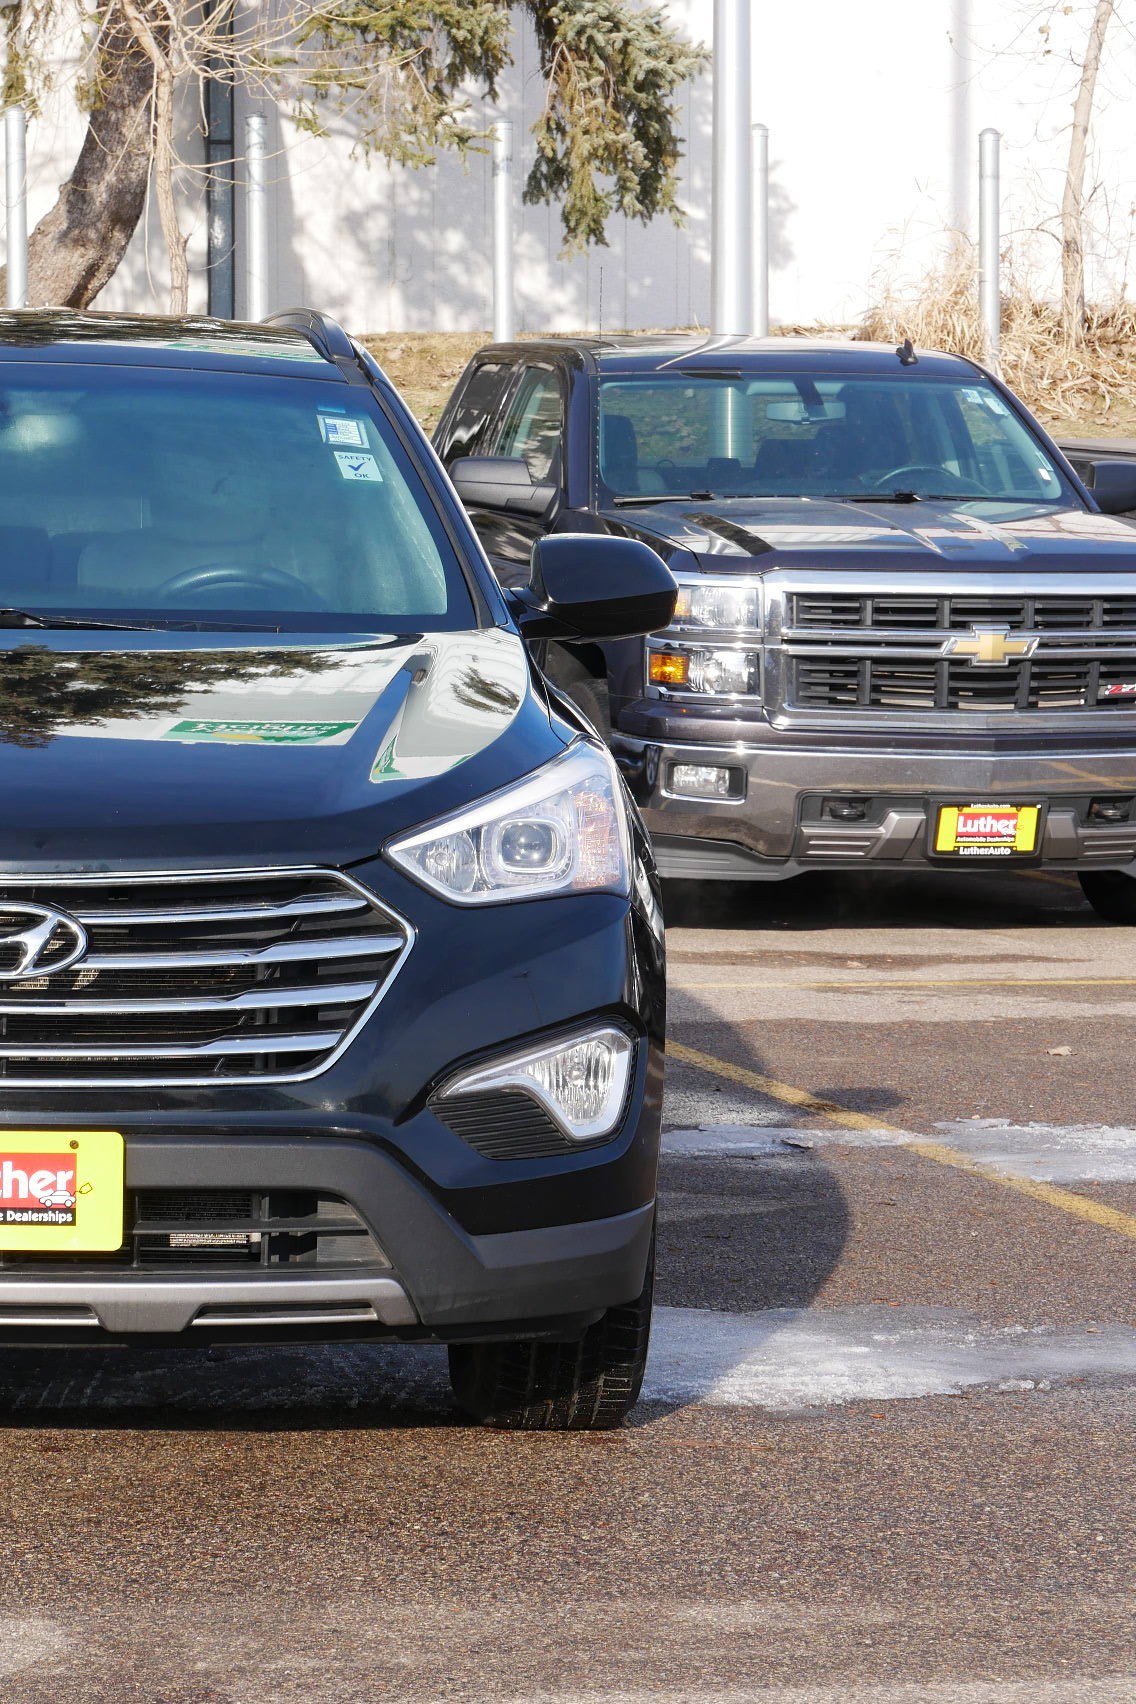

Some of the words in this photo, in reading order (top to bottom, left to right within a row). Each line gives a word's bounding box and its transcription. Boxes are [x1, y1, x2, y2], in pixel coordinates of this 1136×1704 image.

[338, 454, 371, 462] SAFETY
[957, 816, 1017, 833] Luther
[959, 847, 1011, 855] LutherAuto
[6, 1210, 73, 1224] Dealerships
